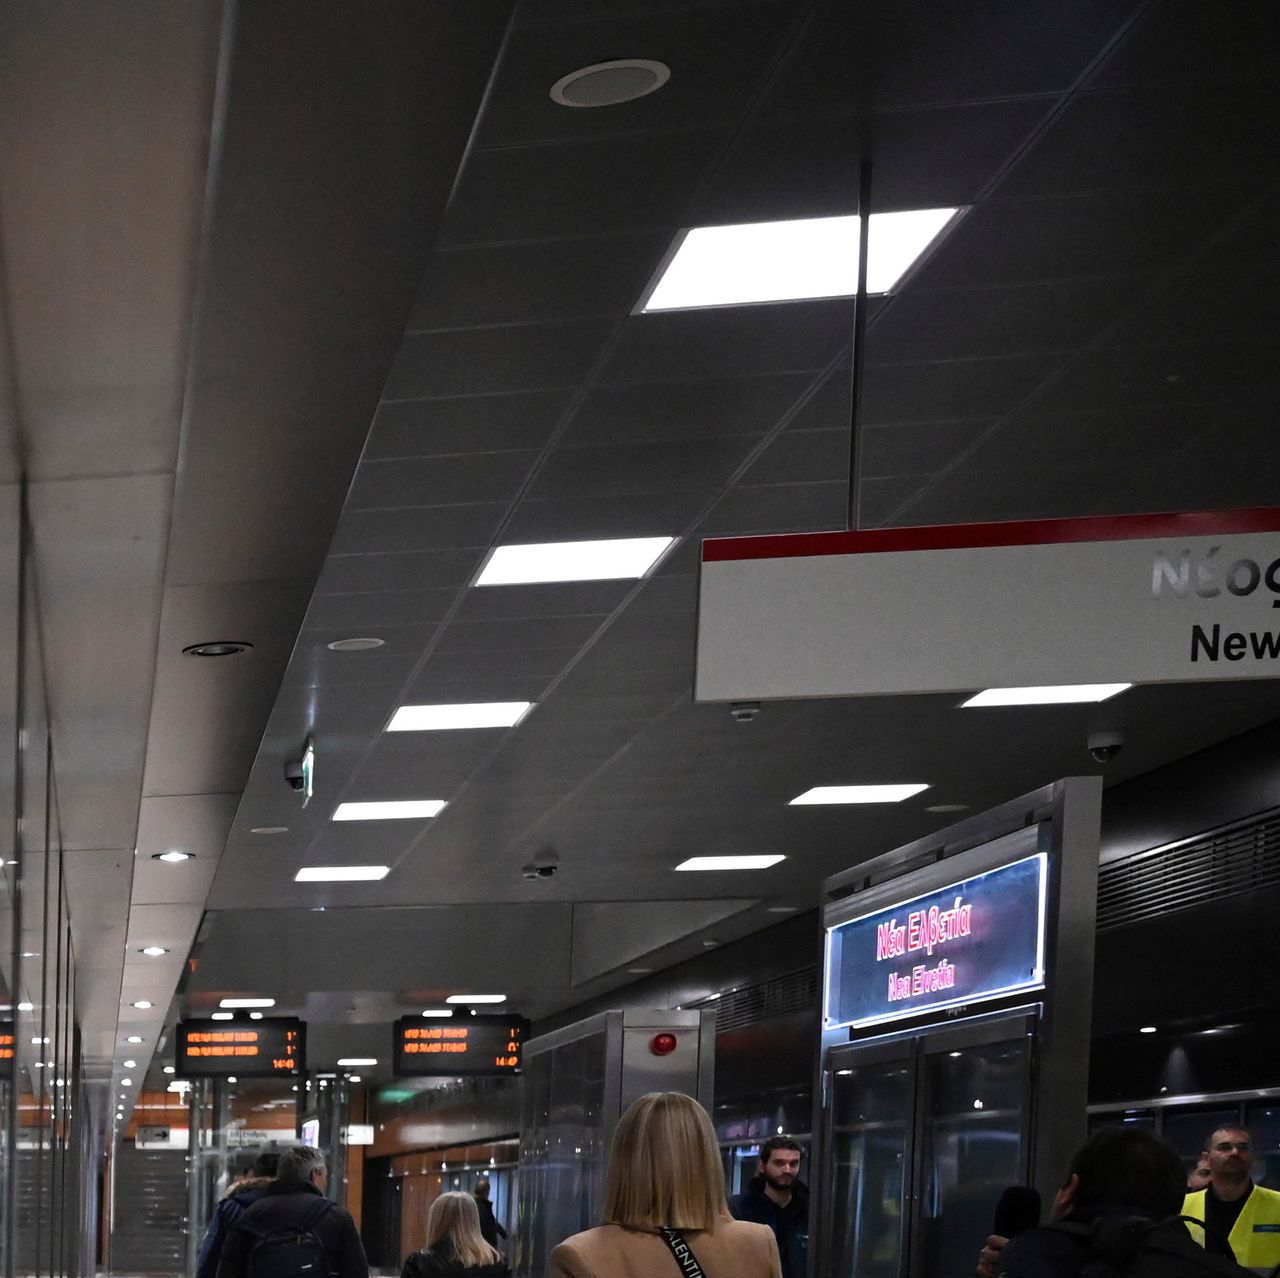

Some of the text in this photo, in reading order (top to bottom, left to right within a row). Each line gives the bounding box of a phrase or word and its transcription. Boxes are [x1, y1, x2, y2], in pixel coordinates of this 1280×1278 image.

[1191, 624, 1279, 662] New
[876, 897, 973, 962] Νέα Ελβετία
[887, 959, 956, 1002] Nea Elvetia
